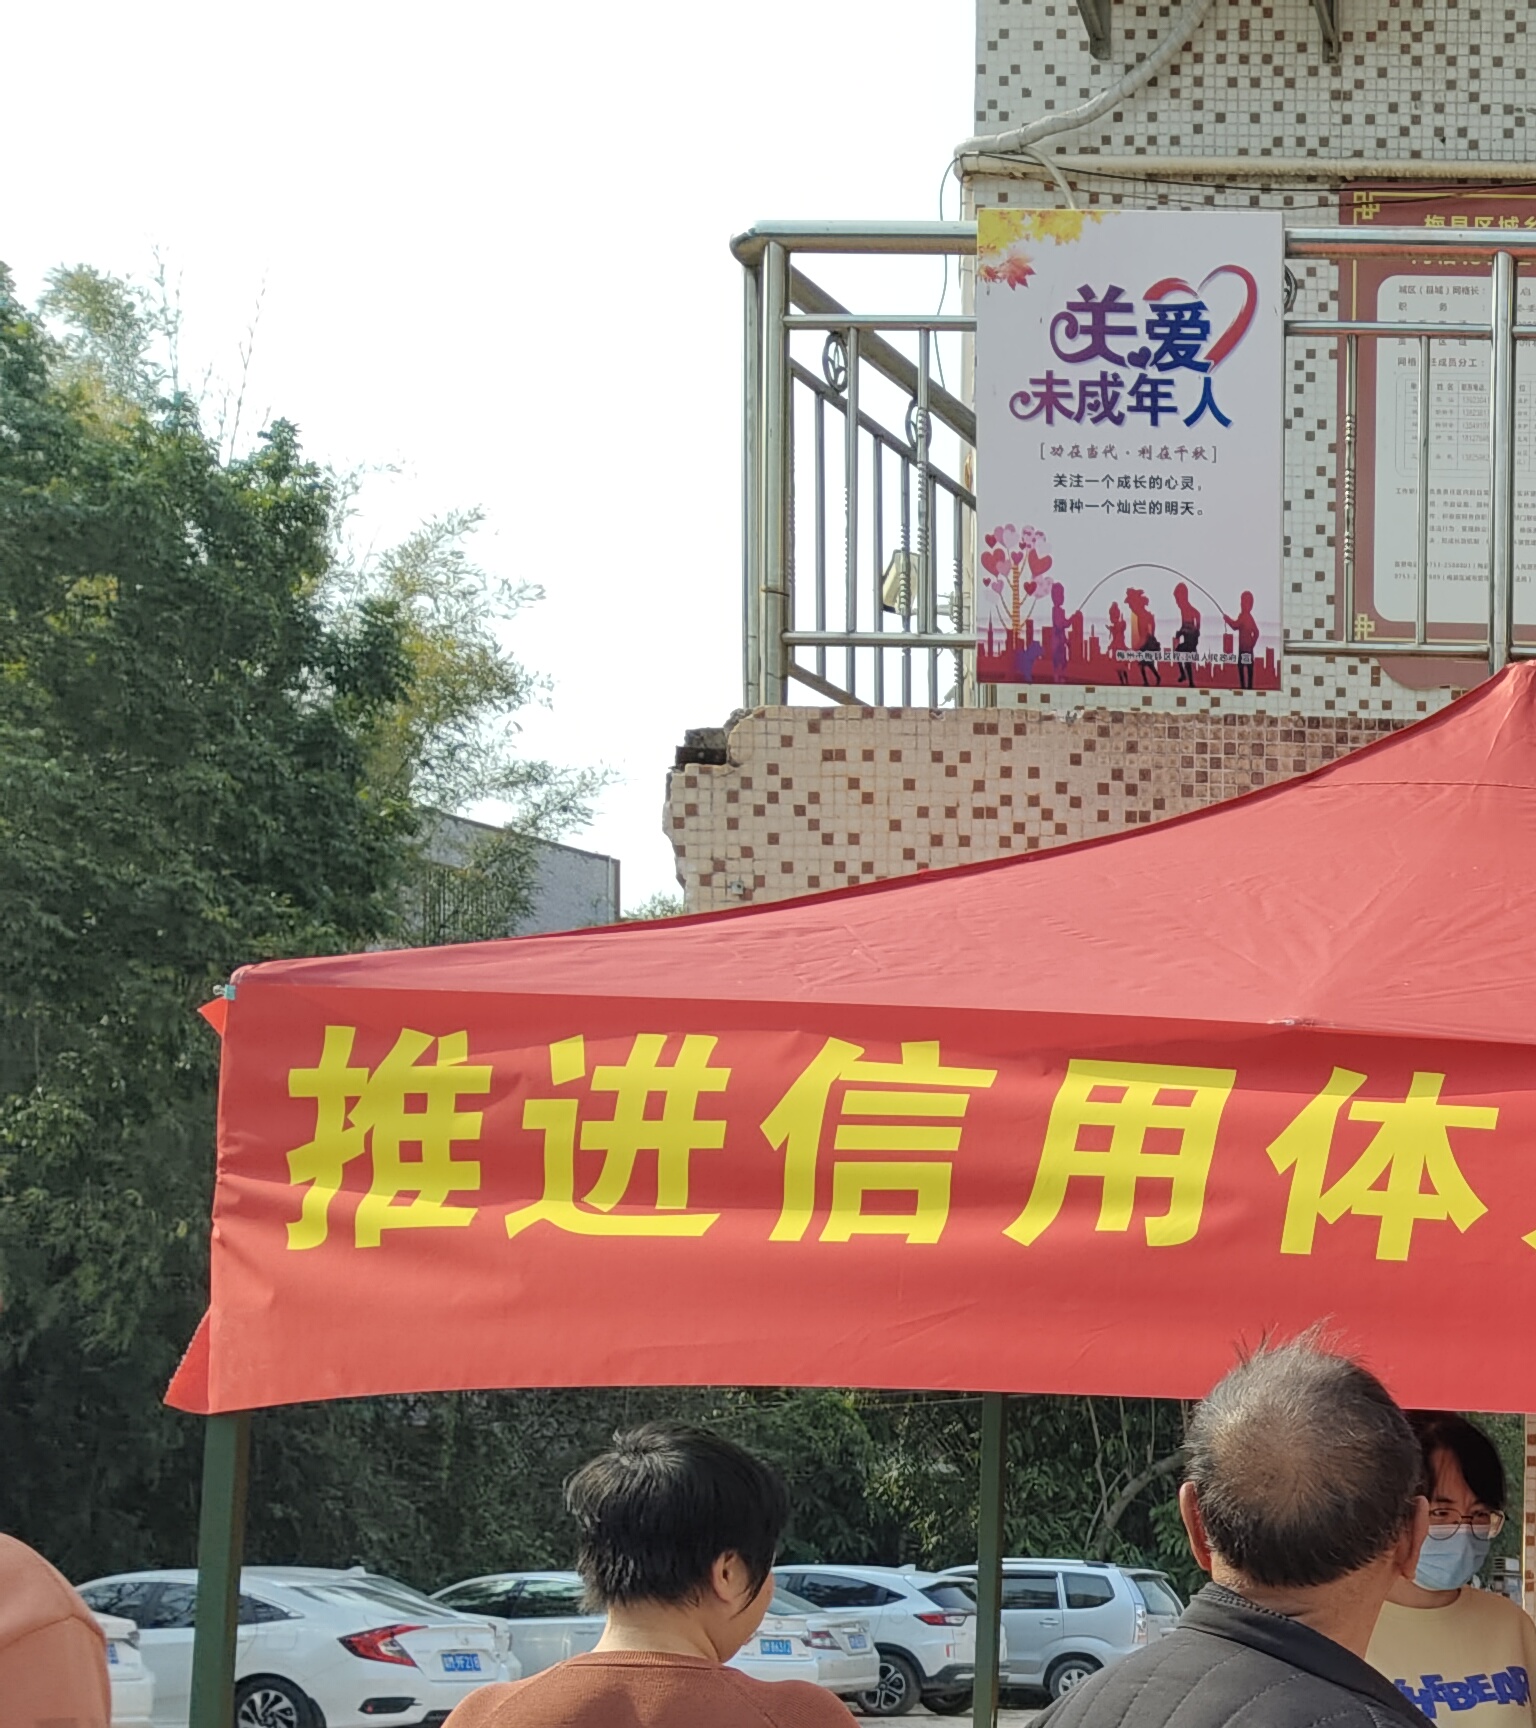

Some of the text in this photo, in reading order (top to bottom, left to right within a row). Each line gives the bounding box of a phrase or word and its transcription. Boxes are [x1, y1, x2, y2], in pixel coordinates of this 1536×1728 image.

[1049, 276, 1212, 373] 关爱
[1008, 369, 1234, 429] 未成年人
